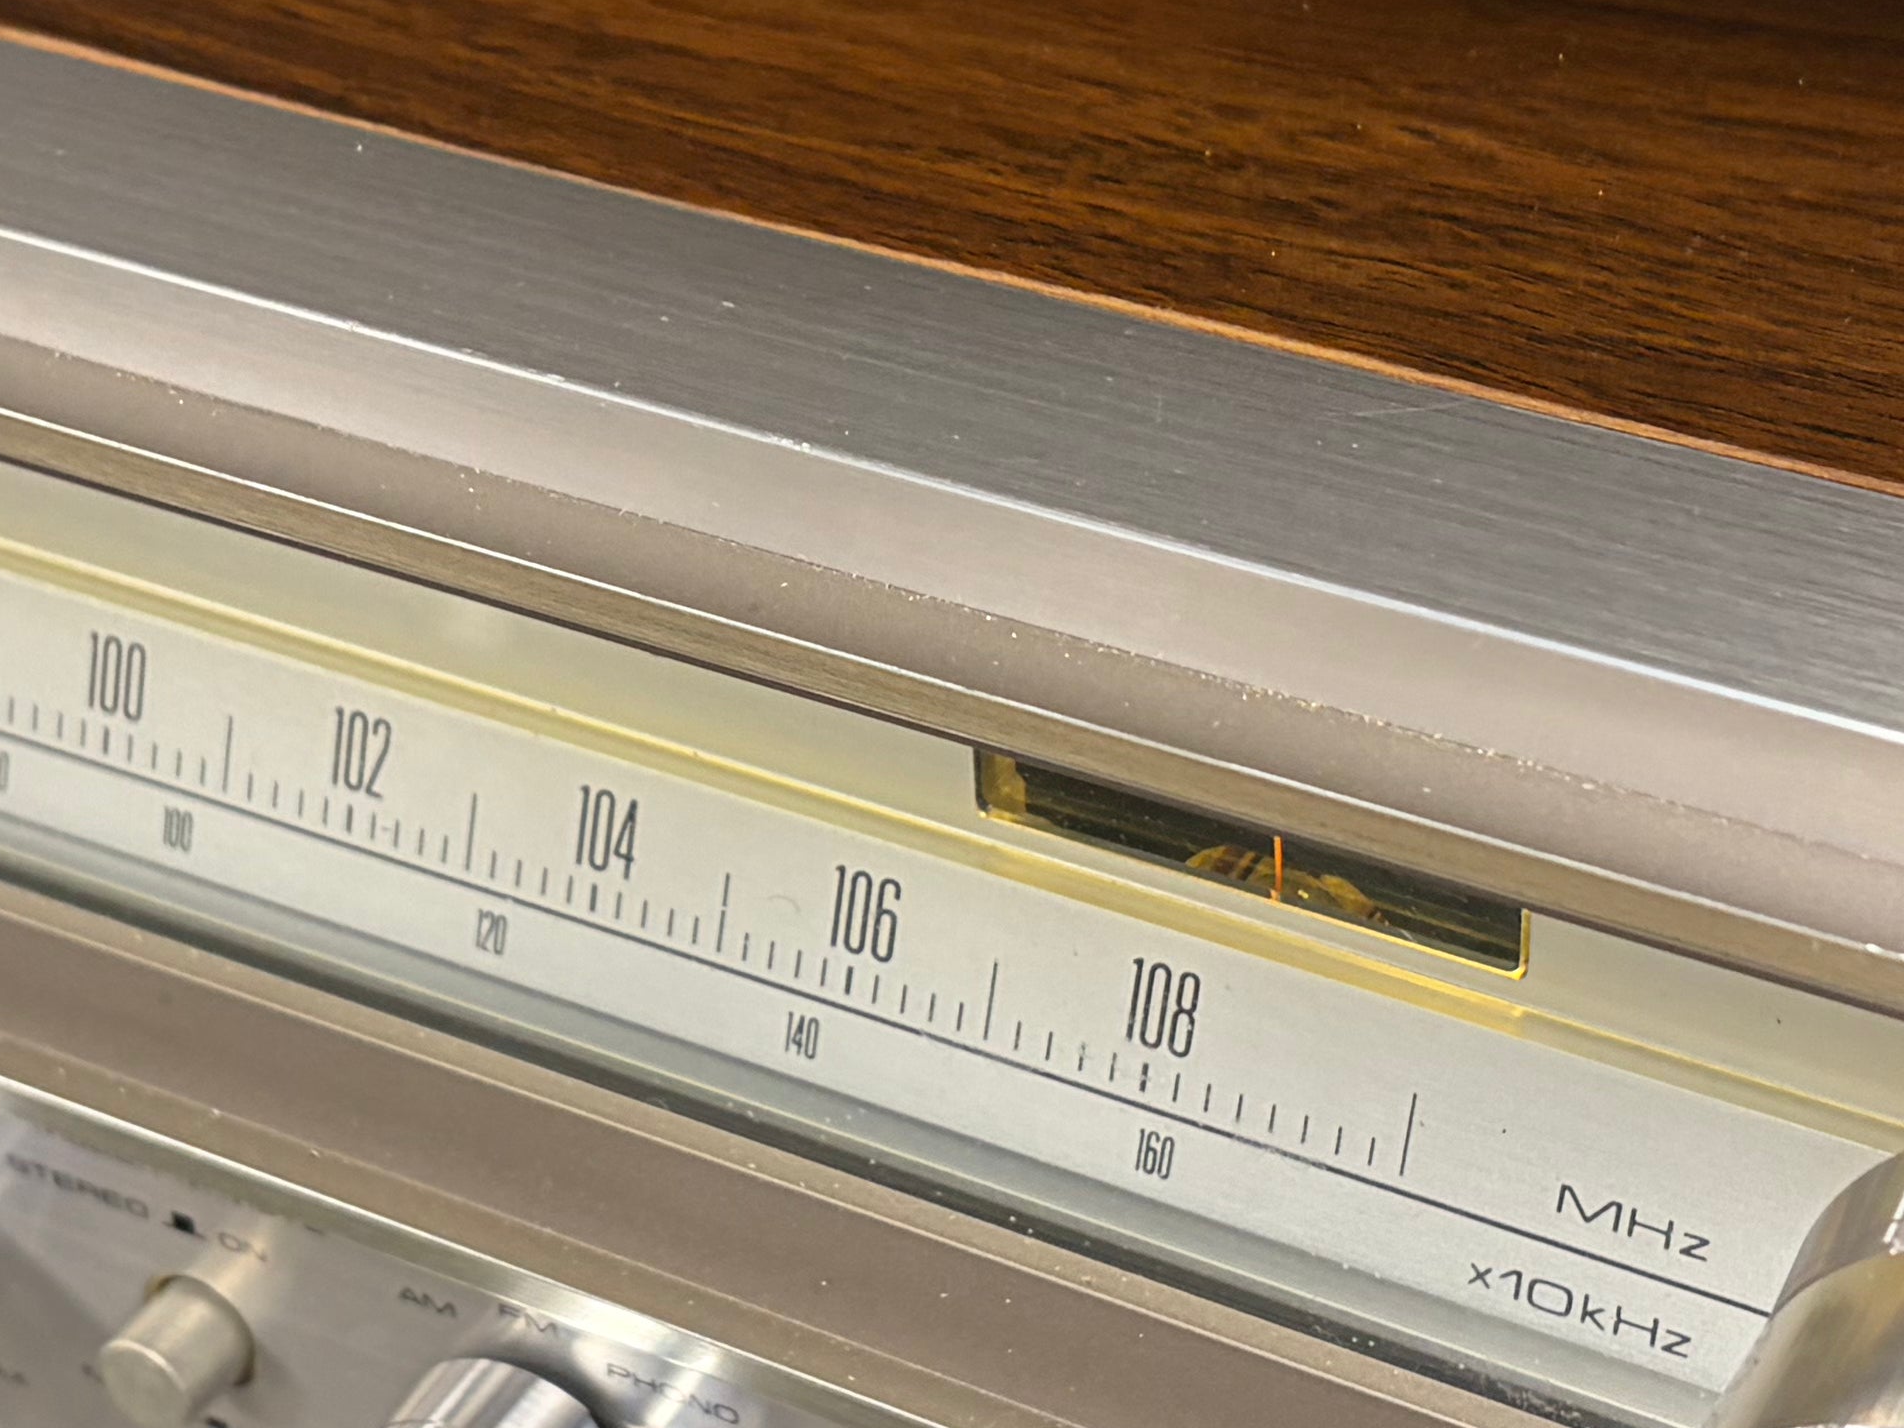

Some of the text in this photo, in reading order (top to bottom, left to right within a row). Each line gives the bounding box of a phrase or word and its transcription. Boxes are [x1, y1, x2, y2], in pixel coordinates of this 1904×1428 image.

[86, 631, 147, 722] 100
[332, 706, 392, 800] 102
[575, 784, 639, 880] 104
[830, 864, 902, 964] 106
[1126, 956, 1201, 1059] 108
[1555, 1183, 1711, 1264] MHz
[162, 805, 194, 854] 100
[475, 909, 506, 957] 120
[785, 1011, 819, 1061] 140
[1134, 1128, 1175, 1181] 160
[398, 1286, 459, 1319] AM
[497, 1302, 559, 1337] FM
[606, 1362, 741, 1425] PHONO
